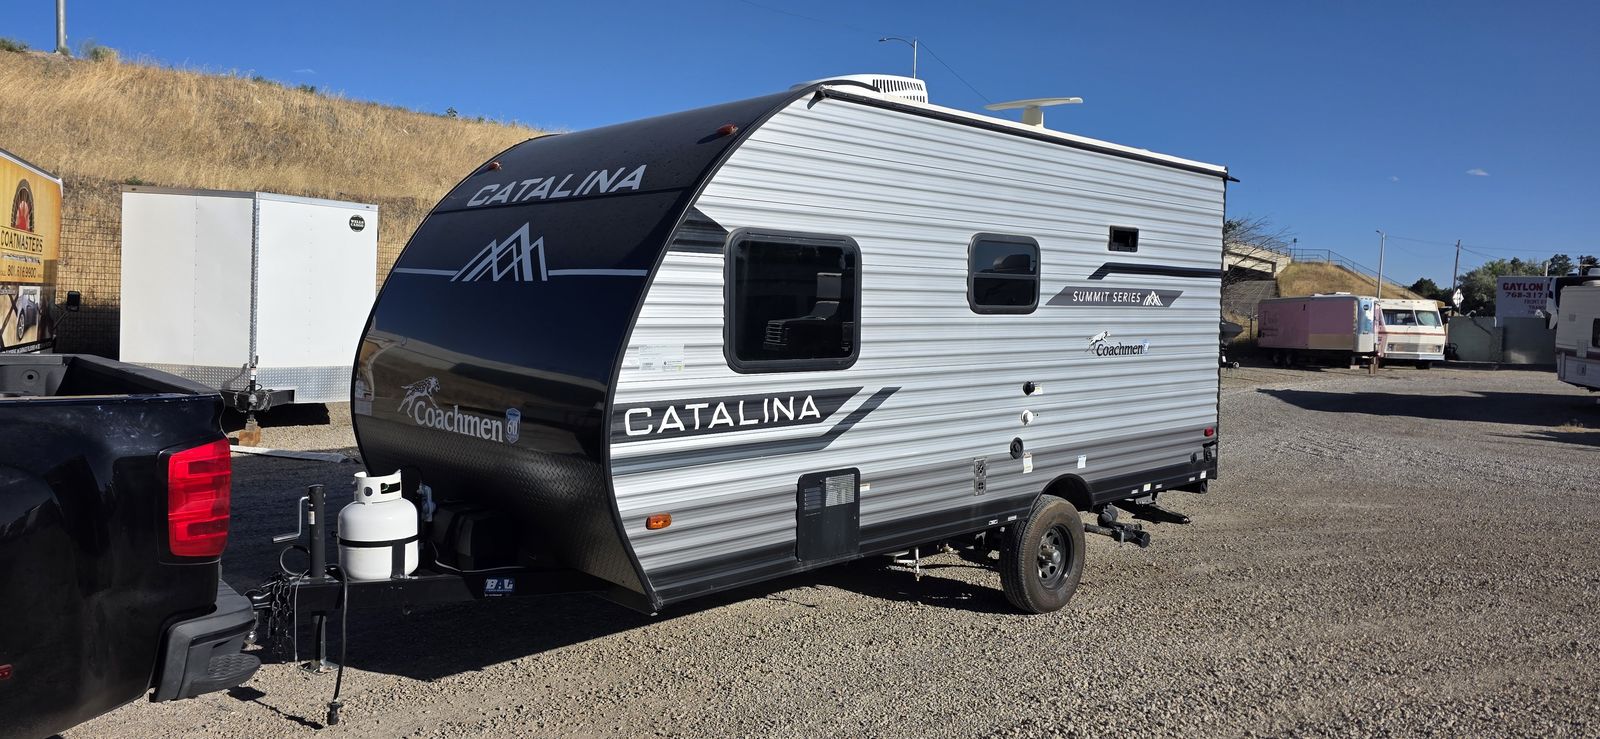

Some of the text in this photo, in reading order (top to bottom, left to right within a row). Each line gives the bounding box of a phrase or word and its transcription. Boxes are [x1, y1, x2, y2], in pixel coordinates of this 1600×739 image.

[467, 164, 647, 207] CATALINA
[0, 229, 44, 253] COATMASTERS
[1072, 290, 1141, 303] SUMMIT SERIES
[1503, 282, 1543, 291] GAYLON
[1096, 342, 1143, 356] Coachmen
[414, 400, 504, 443] Coachmen
[624, 395, 821, 437] CATALINA
